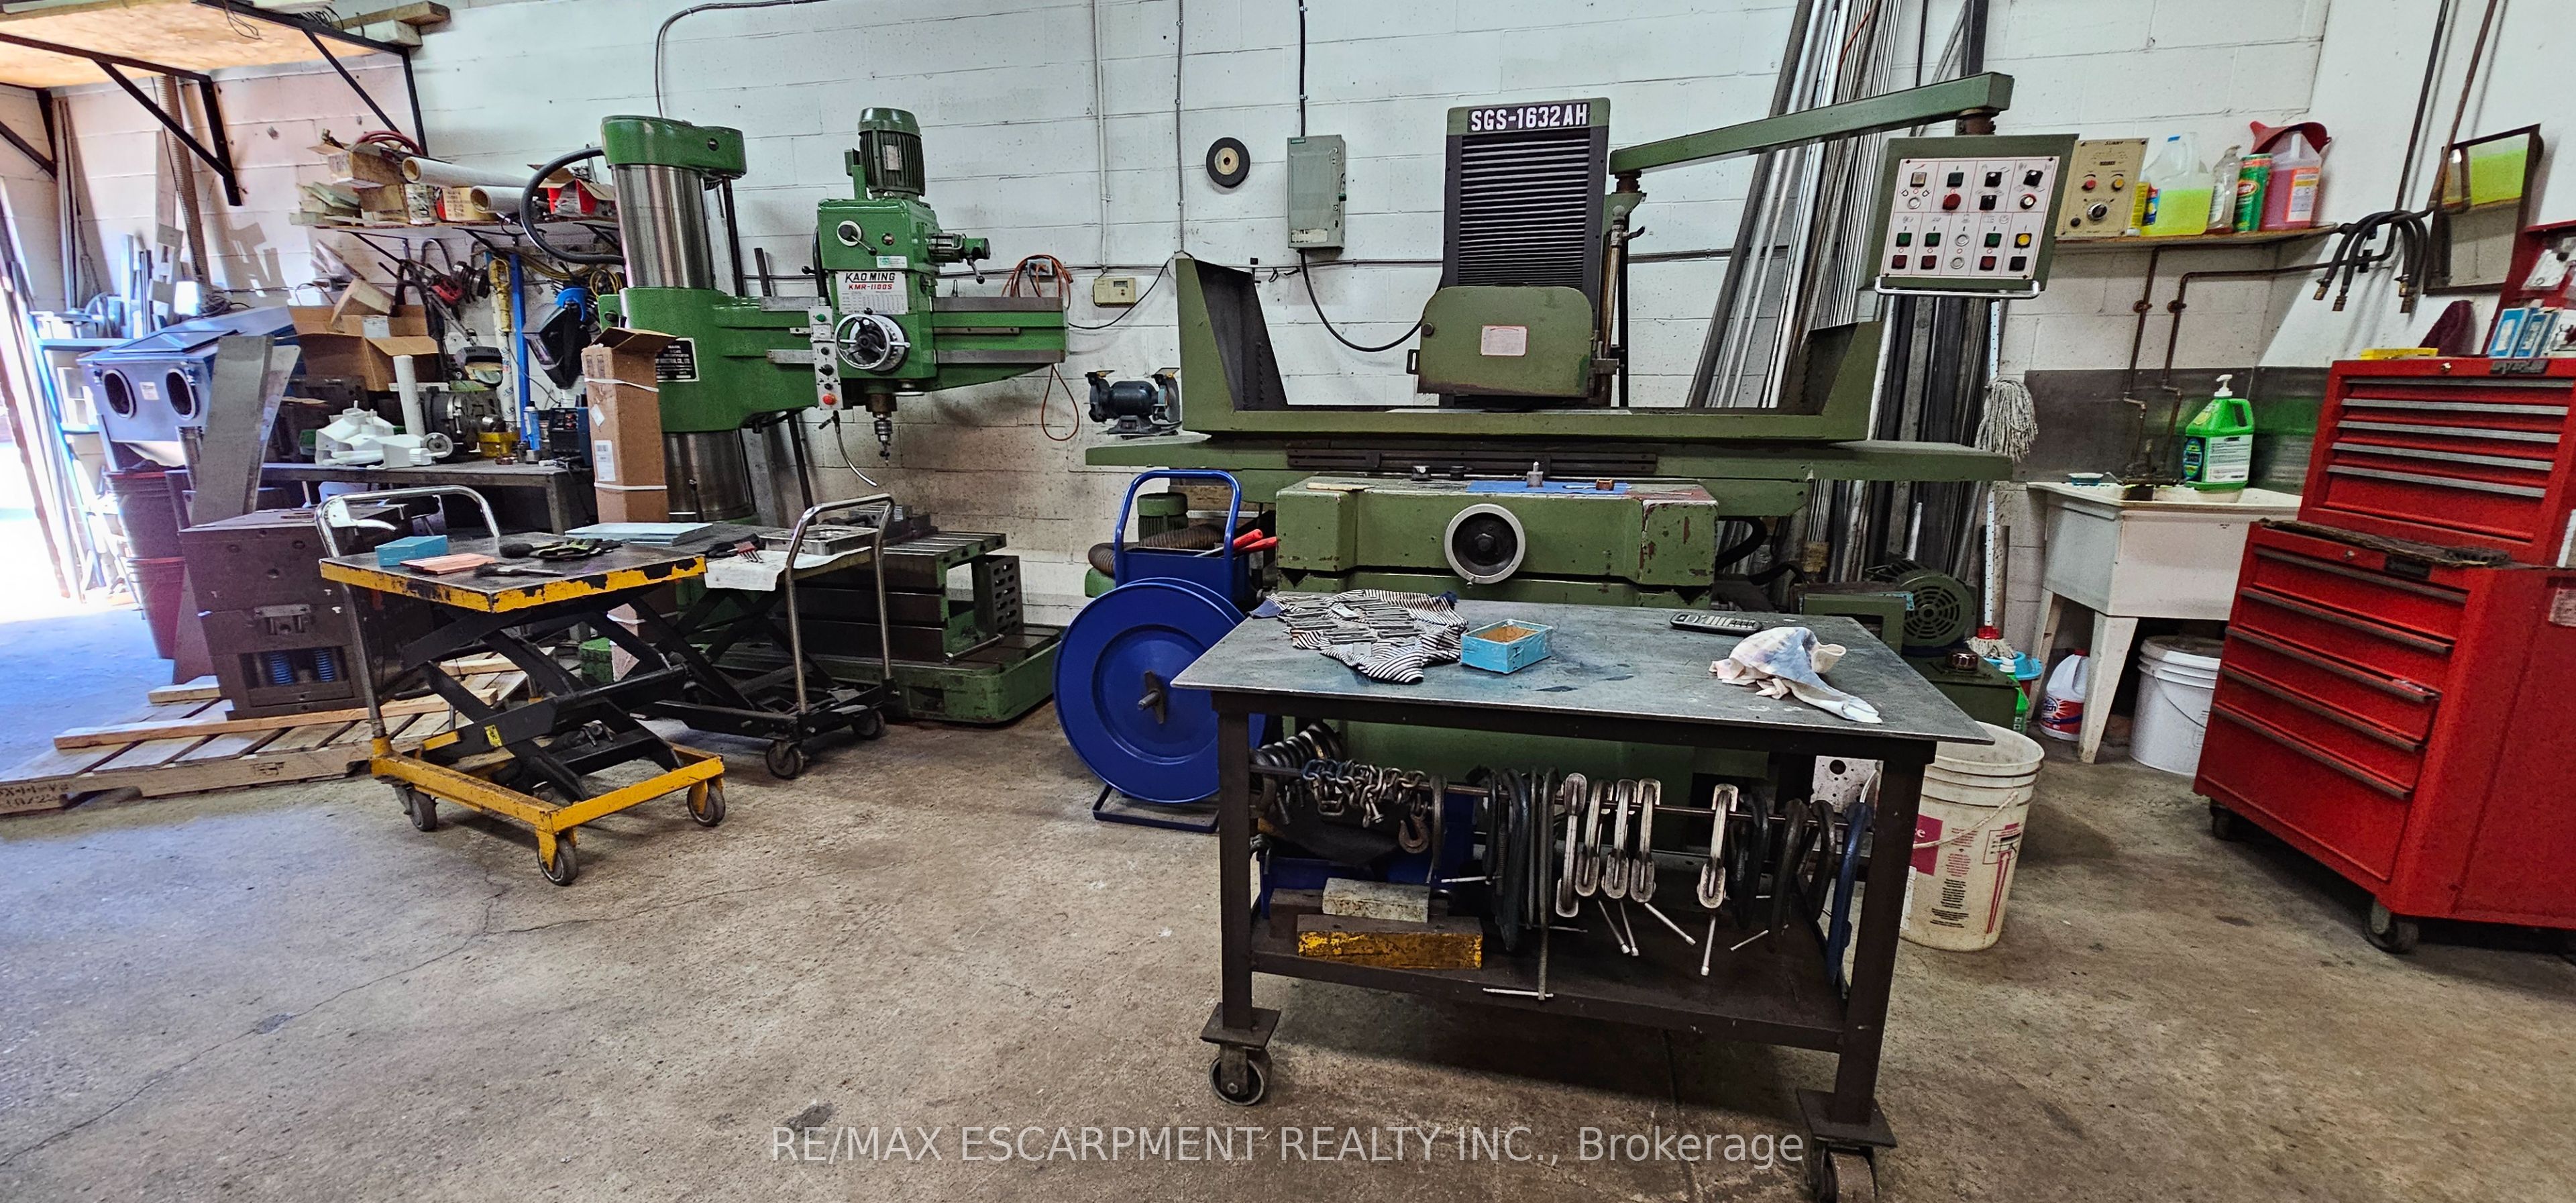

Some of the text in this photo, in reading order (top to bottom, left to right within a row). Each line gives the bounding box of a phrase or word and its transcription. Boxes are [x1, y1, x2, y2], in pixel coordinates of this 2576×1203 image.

[1471, 103, 1587, 132] SGS-1632AH
[845, 272, 896, 282] KAO MING
